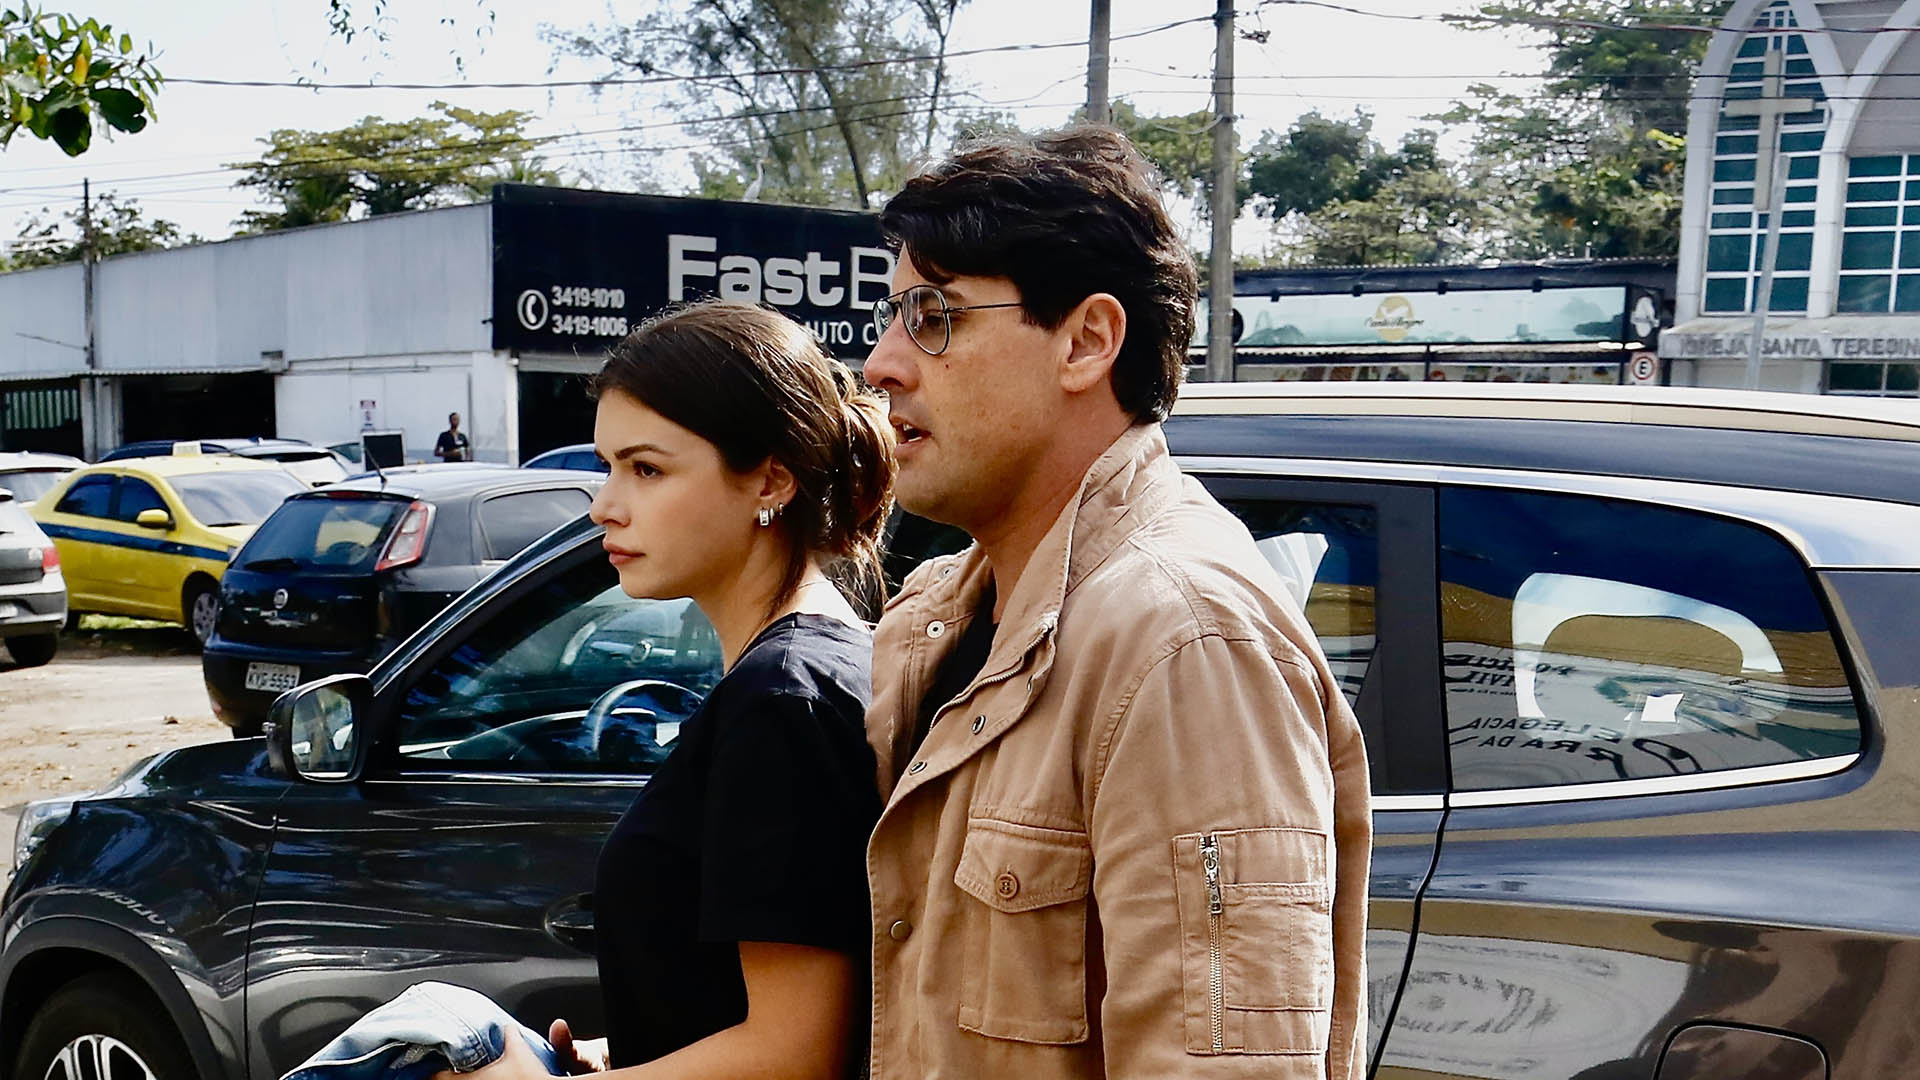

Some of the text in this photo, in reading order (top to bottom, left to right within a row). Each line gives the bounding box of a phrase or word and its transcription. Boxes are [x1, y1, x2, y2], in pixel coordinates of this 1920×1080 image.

[551, 285, 625, 309] 3419-1010
[551, 313, 628, 337] 3419-1006
[805, 319, 853, 345] UTO
[1758, 337, 1822, 356] SANTA
[1639, 360, 1649, 376] E
